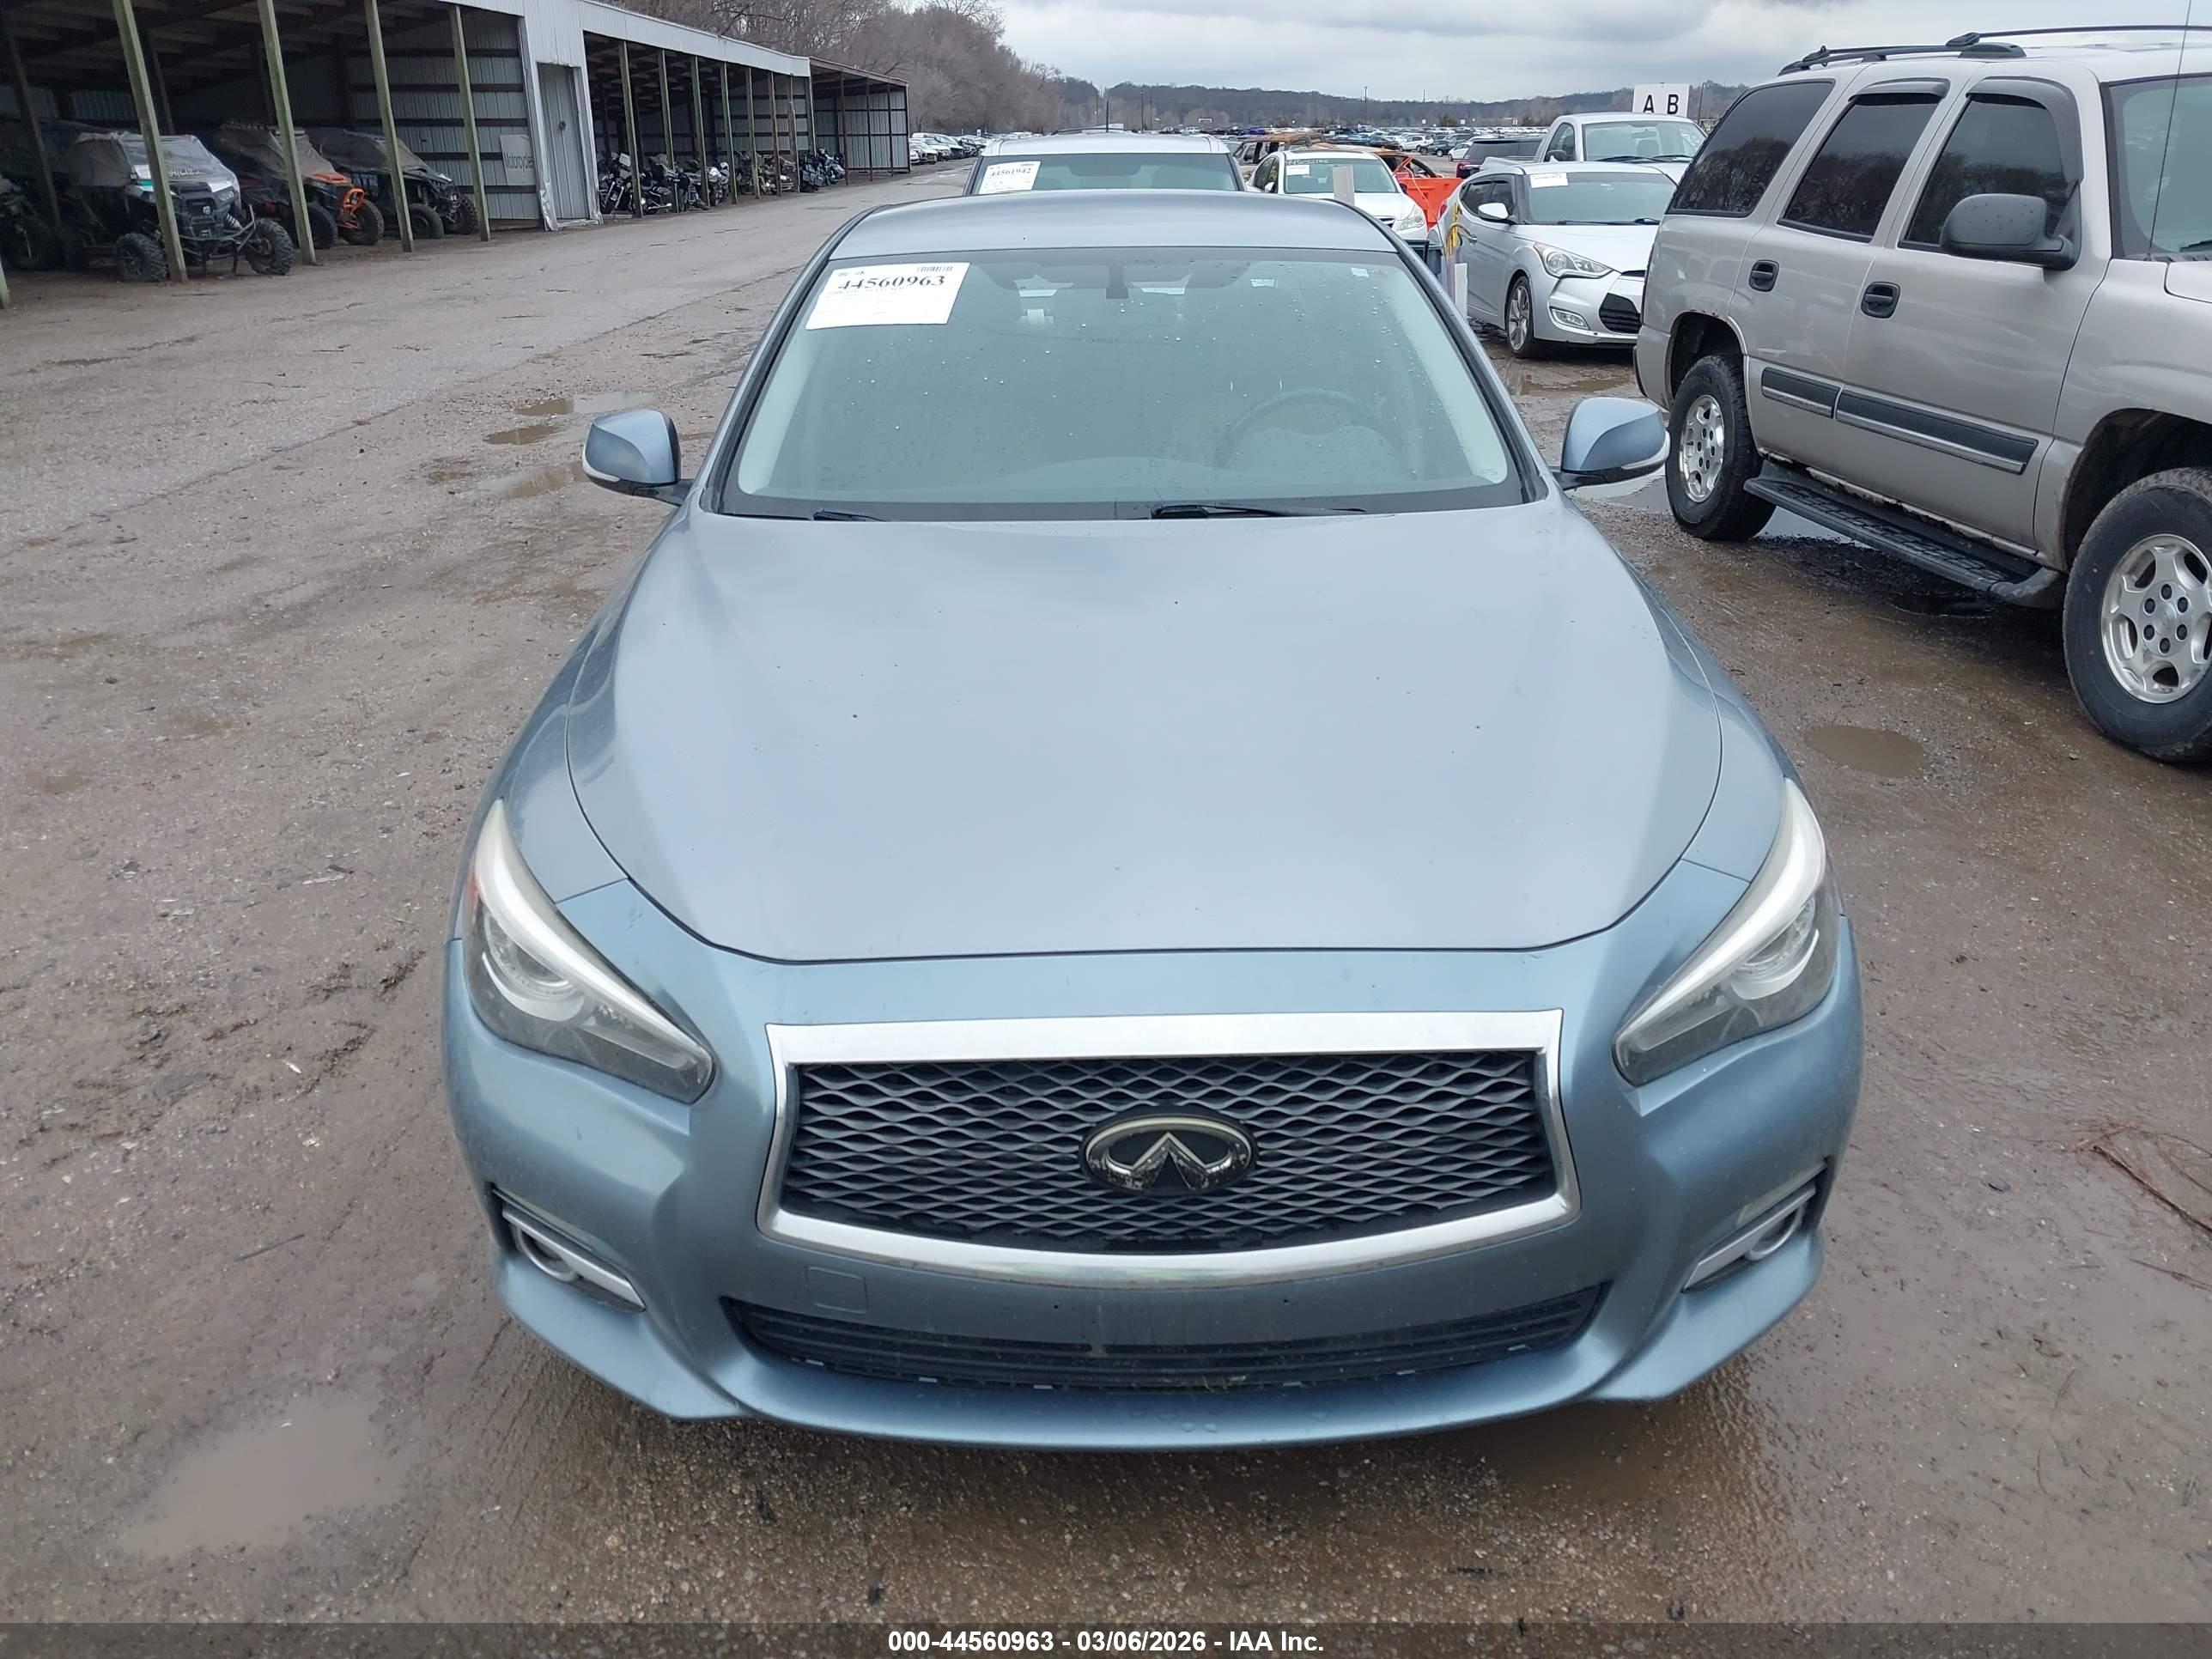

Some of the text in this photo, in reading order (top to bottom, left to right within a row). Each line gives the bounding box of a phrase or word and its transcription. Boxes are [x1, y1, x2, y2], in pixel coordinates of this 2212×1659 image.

[1643, 94, 1679, 114] A B
[838, 275, 945, 289] 44560963
